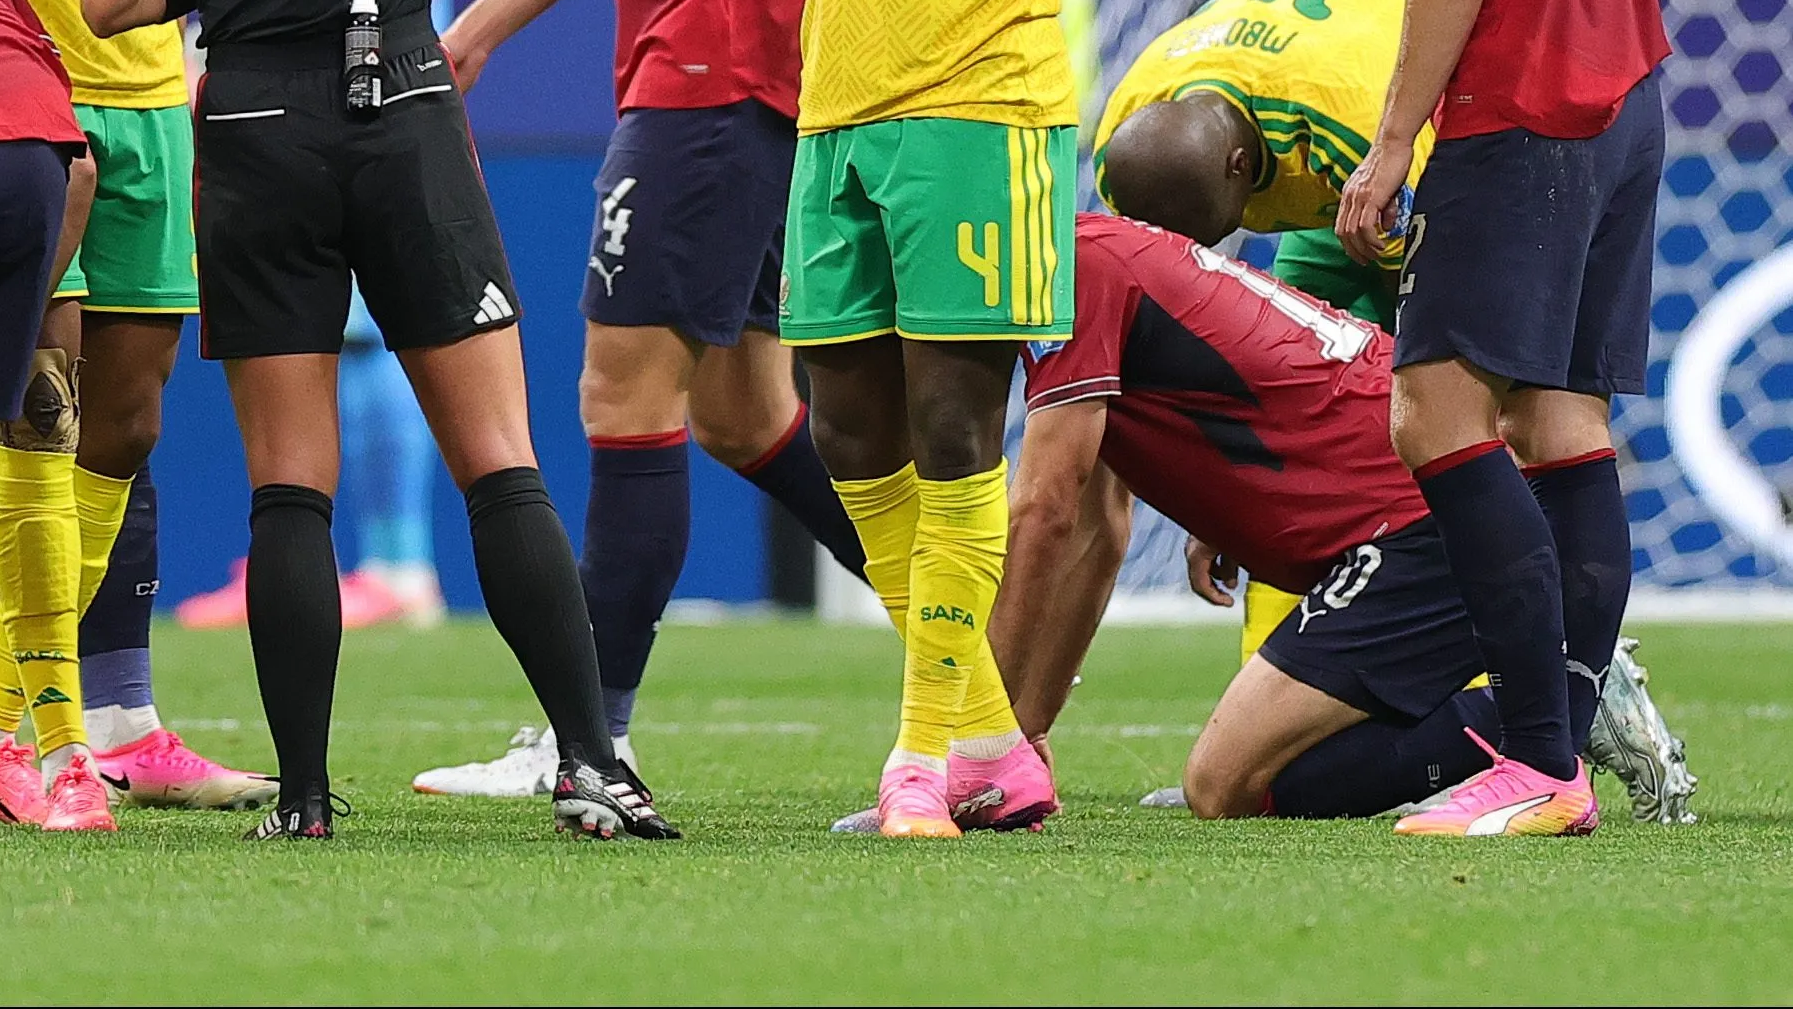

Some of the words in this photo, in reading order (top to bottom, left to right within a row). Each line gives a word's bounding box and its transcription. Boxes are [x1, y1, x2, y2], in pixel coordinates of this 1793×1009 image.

[601, 176, 638, 257] 4
[956, 220, 1001, 308] 4
[920, 604, 976, 632] SAFA
